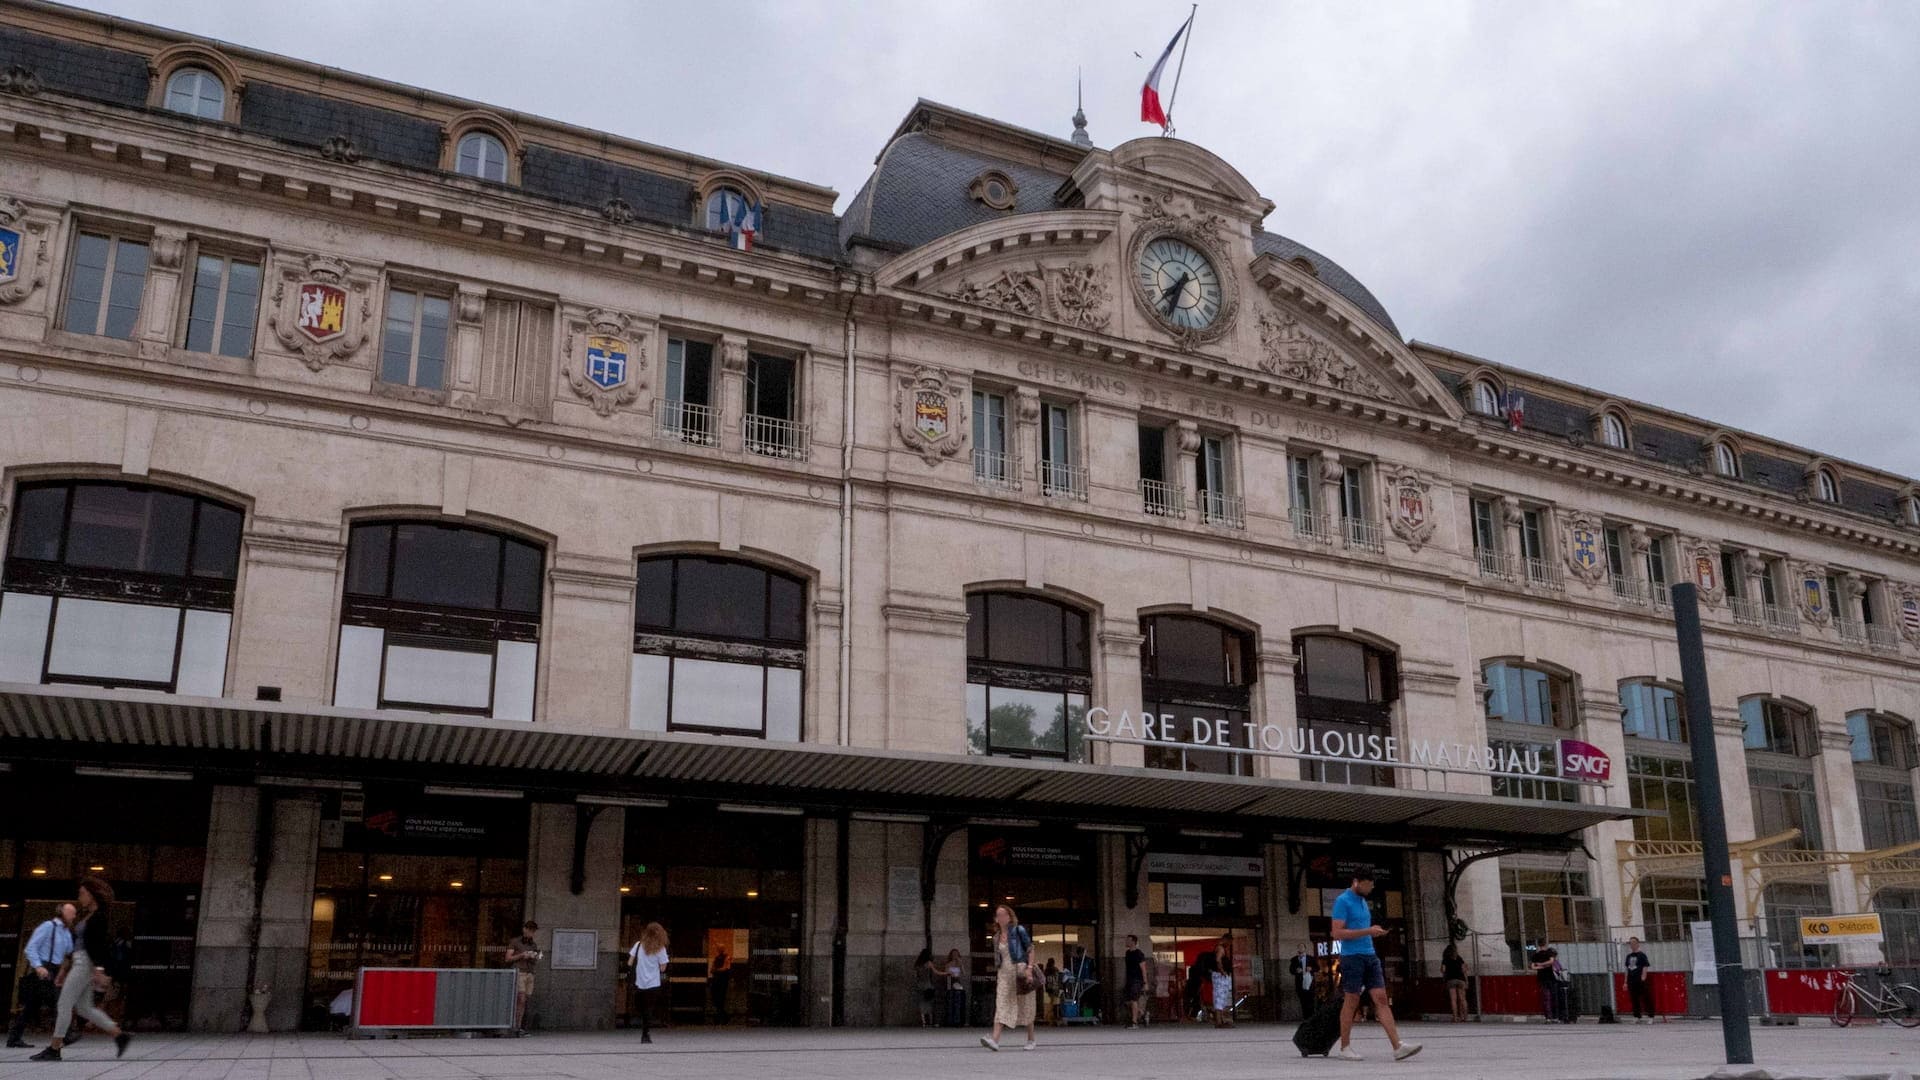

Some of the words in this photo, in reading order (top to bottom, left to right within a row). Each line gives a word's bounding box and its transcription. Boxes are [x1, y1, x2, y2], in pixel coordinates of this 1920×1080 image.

[1017, 360, 1128, 396] CHEMINS
[1142, 387, 1173, 407] DE
[1189, 397, 1236, 421] FER
[1250, 410, 1281, 430] DU
[1296, 420, 1340, 444] MIDI
[1086, 707, 1176, 742] GARE
[1192, 716, 1231, 747] DE
[1243, 722, 1400, 762] TOULOUSE
[1410, 739, 1541, 775] MATABIAU
[1565, 753, 1610, 774] SNCF
[1838, 921, 1875, 931] Piétons
